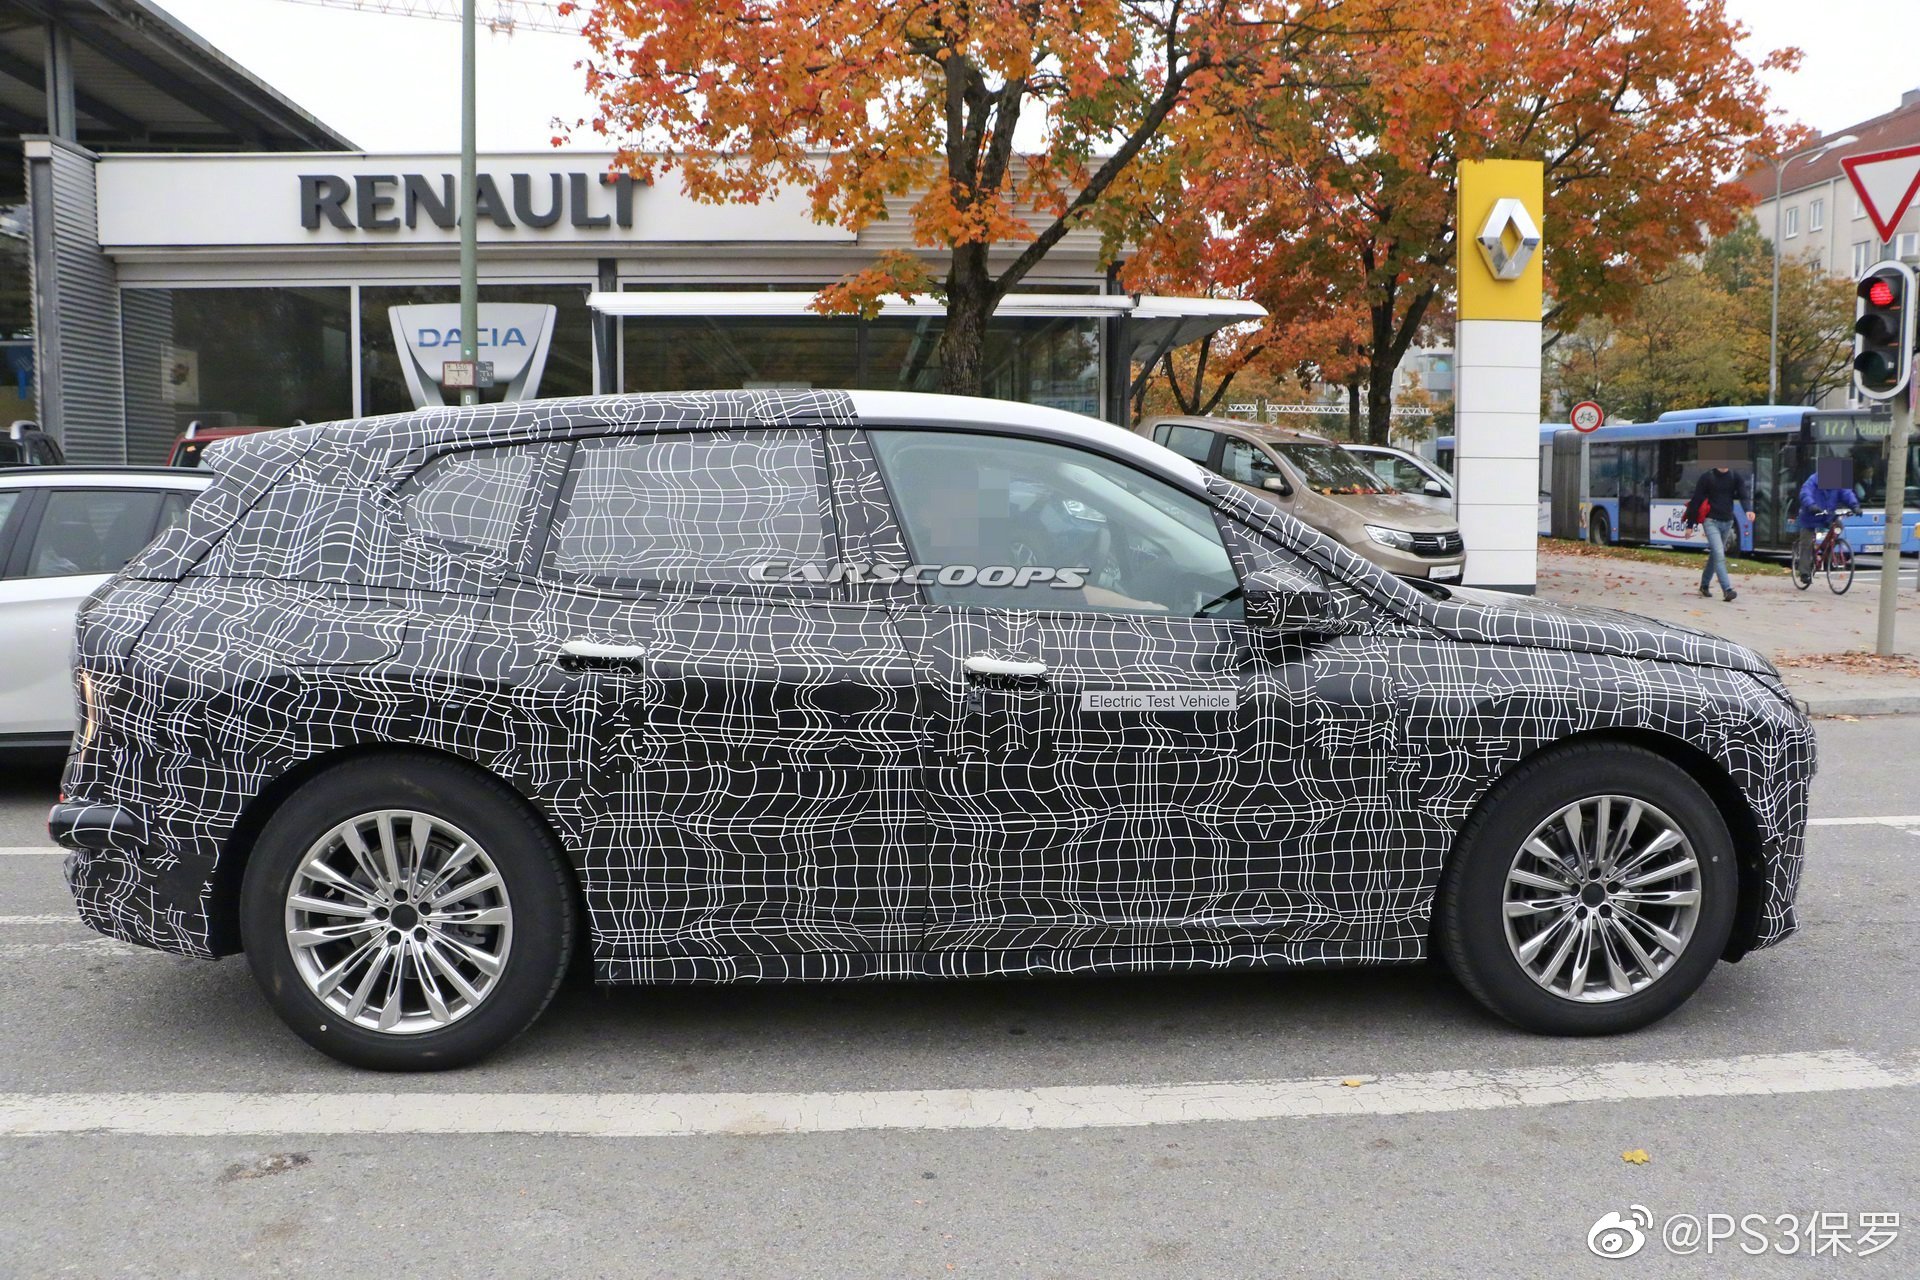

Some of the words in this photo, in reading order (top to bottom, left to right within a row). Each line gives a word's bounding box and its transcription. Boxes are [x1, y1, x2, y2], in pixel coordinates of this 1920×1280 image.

[298, 173, 652, 230] RENAULT
[1824, 420, 1848, 437] 177
[1089, 694, 1142, 708] Electric
[1146, 694, 1176, 708] Test
[1179, 694, 1230, 708] Vehicle
